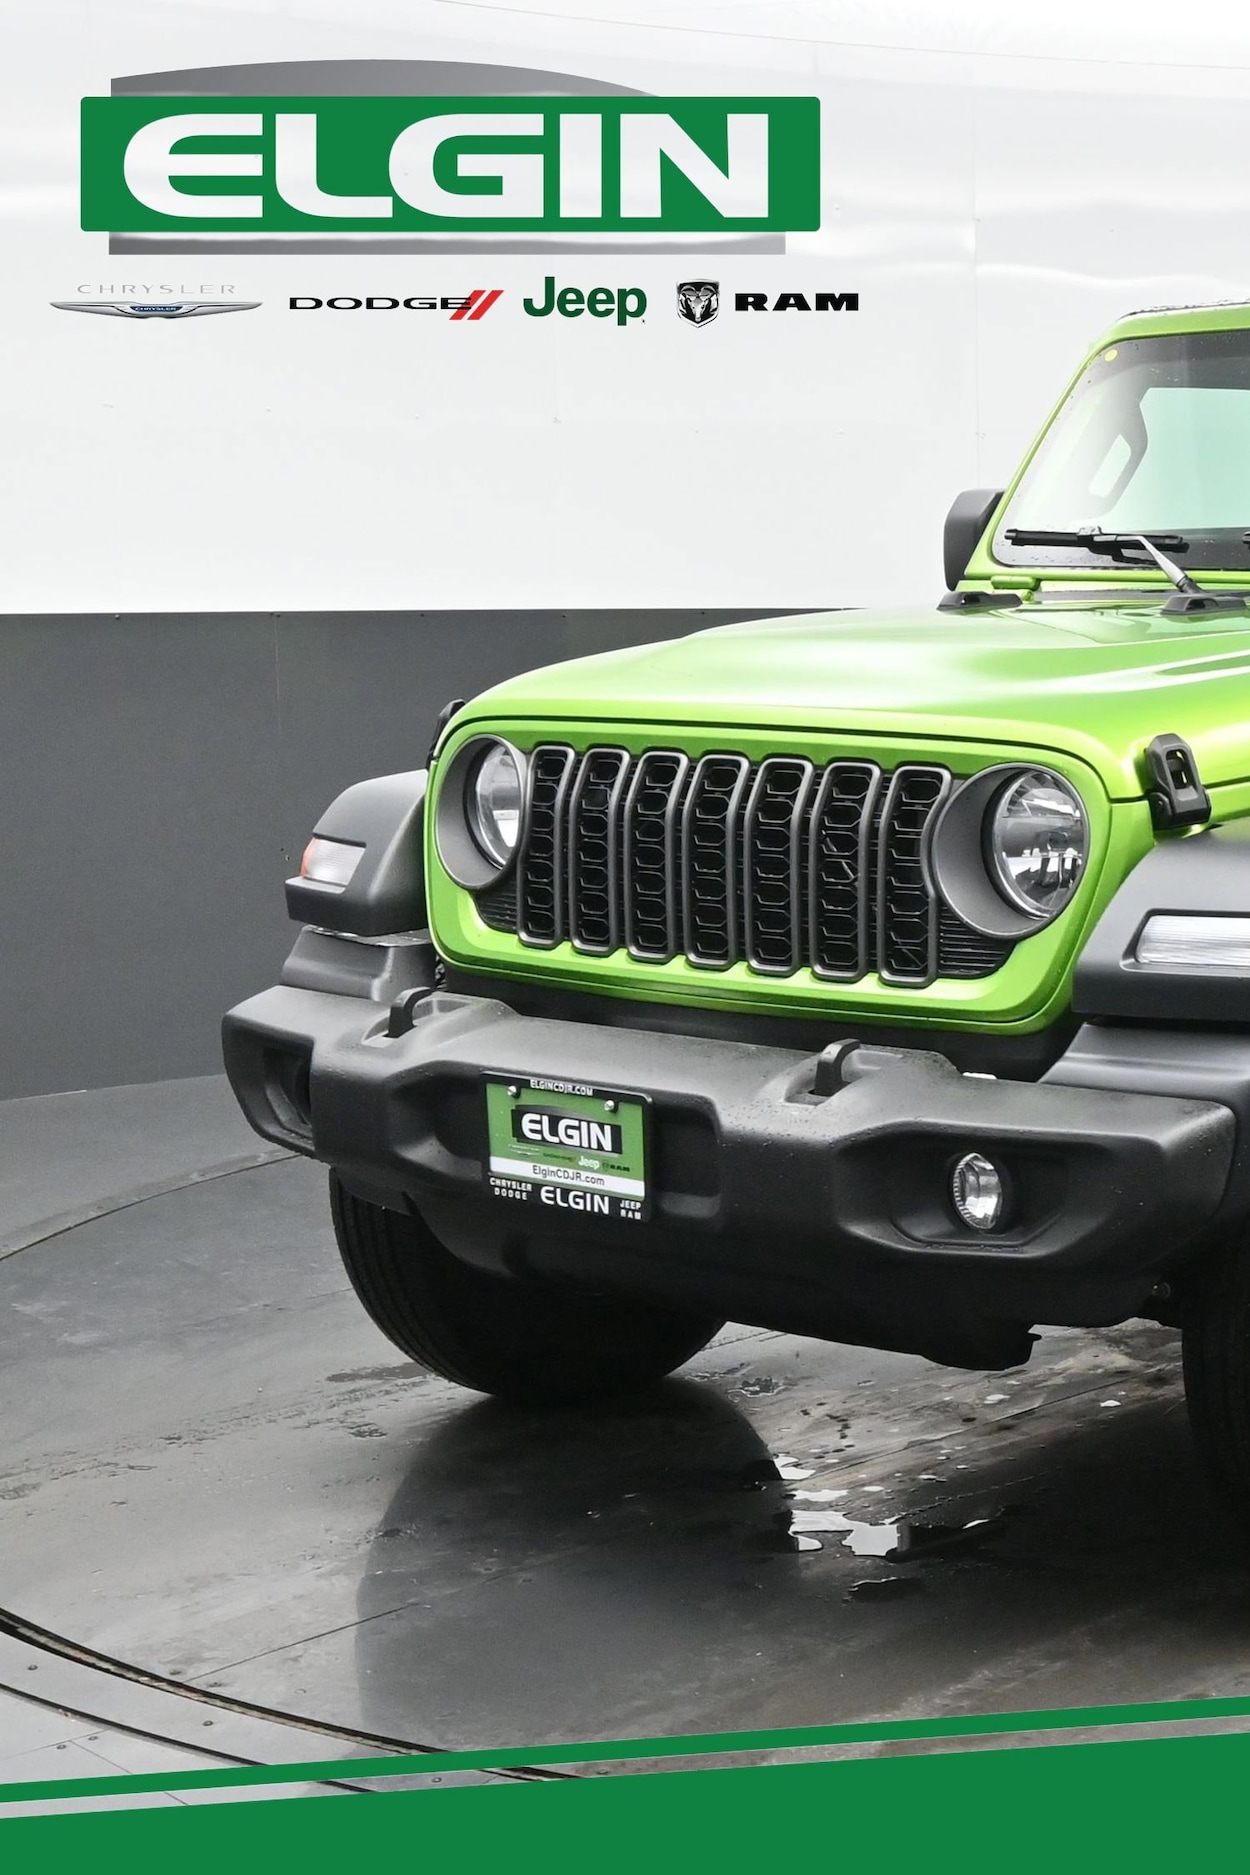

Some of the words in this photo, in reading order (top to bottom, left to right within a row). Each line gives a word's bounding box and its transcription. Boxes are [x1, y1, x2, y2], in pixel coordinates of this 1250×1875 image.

[530, 1079, 593, 1096] ELGINCDJR.COM
[521, 1112, 612, 1152] ELGIN
[532, 1165, 605, 1186] ElginCDJR.com
[490, 1177, 532, 1191] CHRYSLER
[494, 1187, 527, 1200] DODGE
[540, 1186, 610, 1215] ELGIN
[620, 1200, 642, 1210] JEEP
[620, 1209, 642, 1220] RAM
